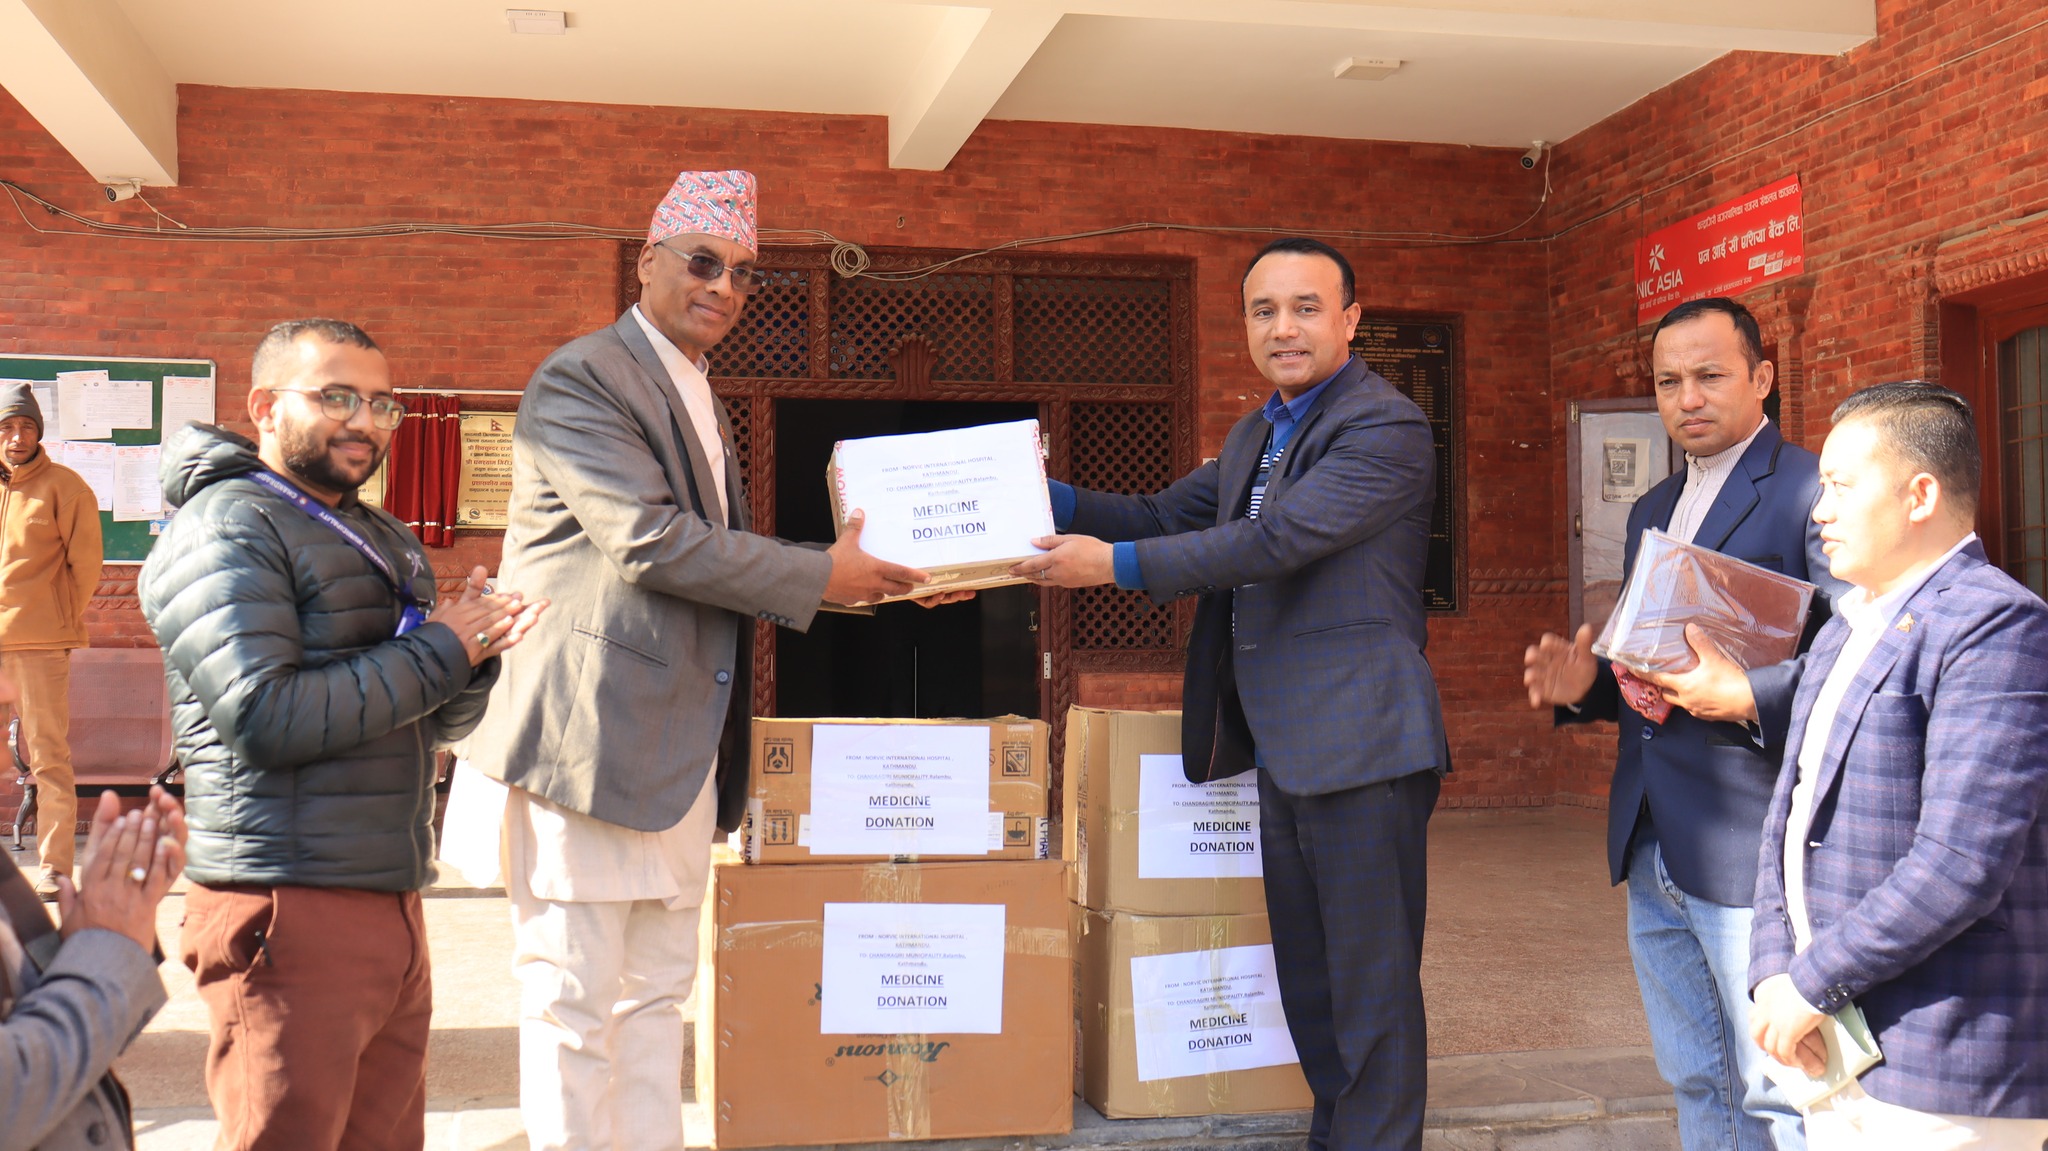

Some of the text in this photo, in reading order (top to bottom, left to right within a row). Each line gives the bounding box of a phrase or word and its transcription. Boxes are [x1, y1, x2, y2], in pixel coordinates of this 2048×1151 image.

[1698, 215, 1800, 264] एन आई सी एशिया बैंक लि.
[1637, 278, 1654, 299] NIC
[1656, 269, 1683, 293] ASIA
[913, 500, 979, 517] MEDICINE
[913, 521, 986, 540] DONATION
[869, 796, 931, 806] MEDICINE
[865, 817, 934, 828] DONATION
[1193, 821, 1251, 832] MEDICINE
[1190, 841, 1255, 852] DONATION
[881, 974, 944, 985] MEDICINE
[877, 996, 947, 1007] DONATION
[1190, 1013, 1248, 1029] MEDICINE
[1188, 1033, 1252, 1050] DONATION
[835, 1042, 950, 1062] Romsons
